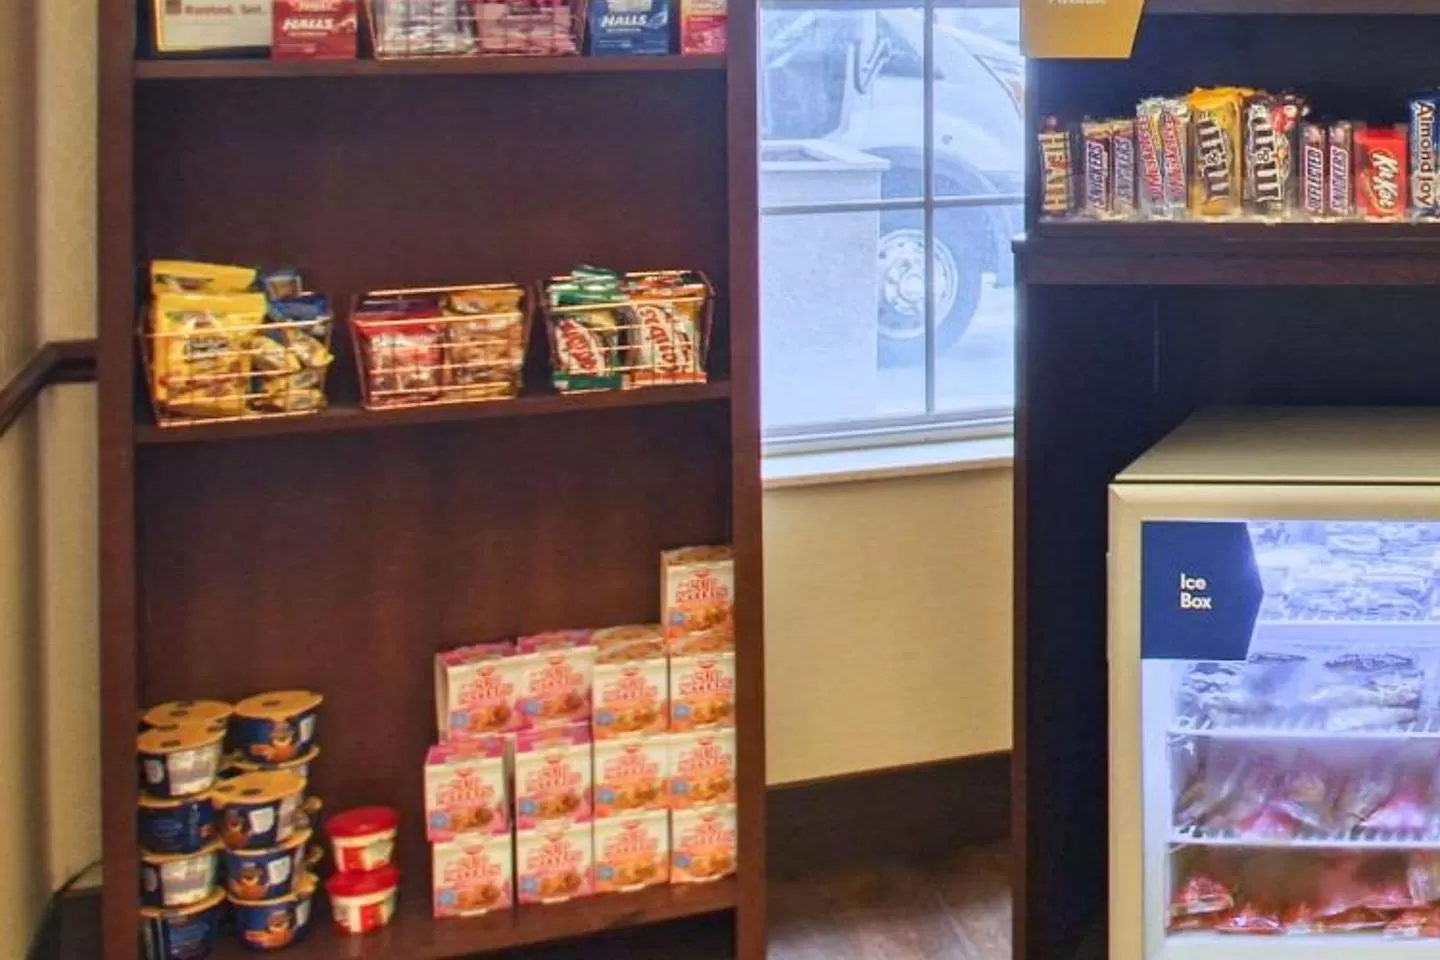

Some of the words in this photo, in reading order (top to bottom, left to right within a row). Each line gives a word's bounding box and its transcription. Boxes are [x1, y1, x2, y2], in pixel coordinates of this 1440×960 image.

[600, 15, 648, 28] HALLS
[1417, 103, 1433, 172] Almond
[1416, 173, 1432, 206] Joy
[1180, 573, 1207, 591] Ice
[1180, 593, 1212, 610] Box
